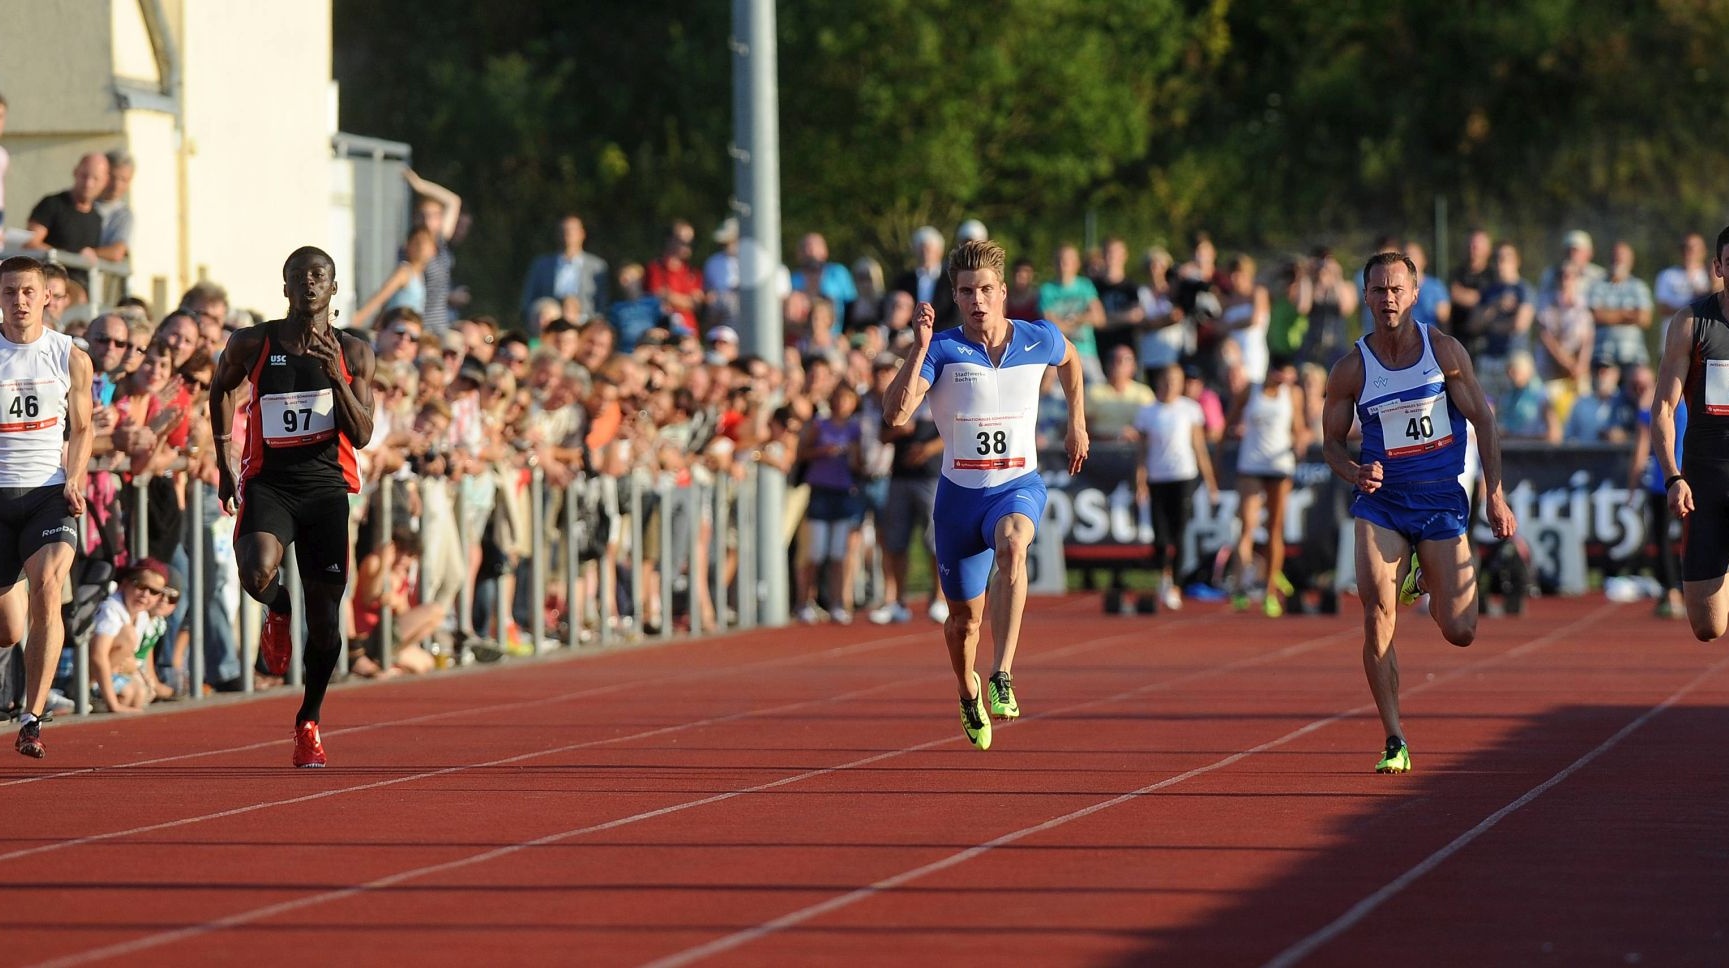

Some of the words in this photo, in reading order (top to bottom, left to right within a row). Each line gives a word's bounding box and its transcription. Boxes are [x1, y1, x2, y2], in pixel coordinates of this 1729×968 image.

[9, 395, 39, 418] 46
[282, 408, 313, 433] 97
[1405, 415, 1434, 441] 40
[976, 430, 1007, 455] 38
